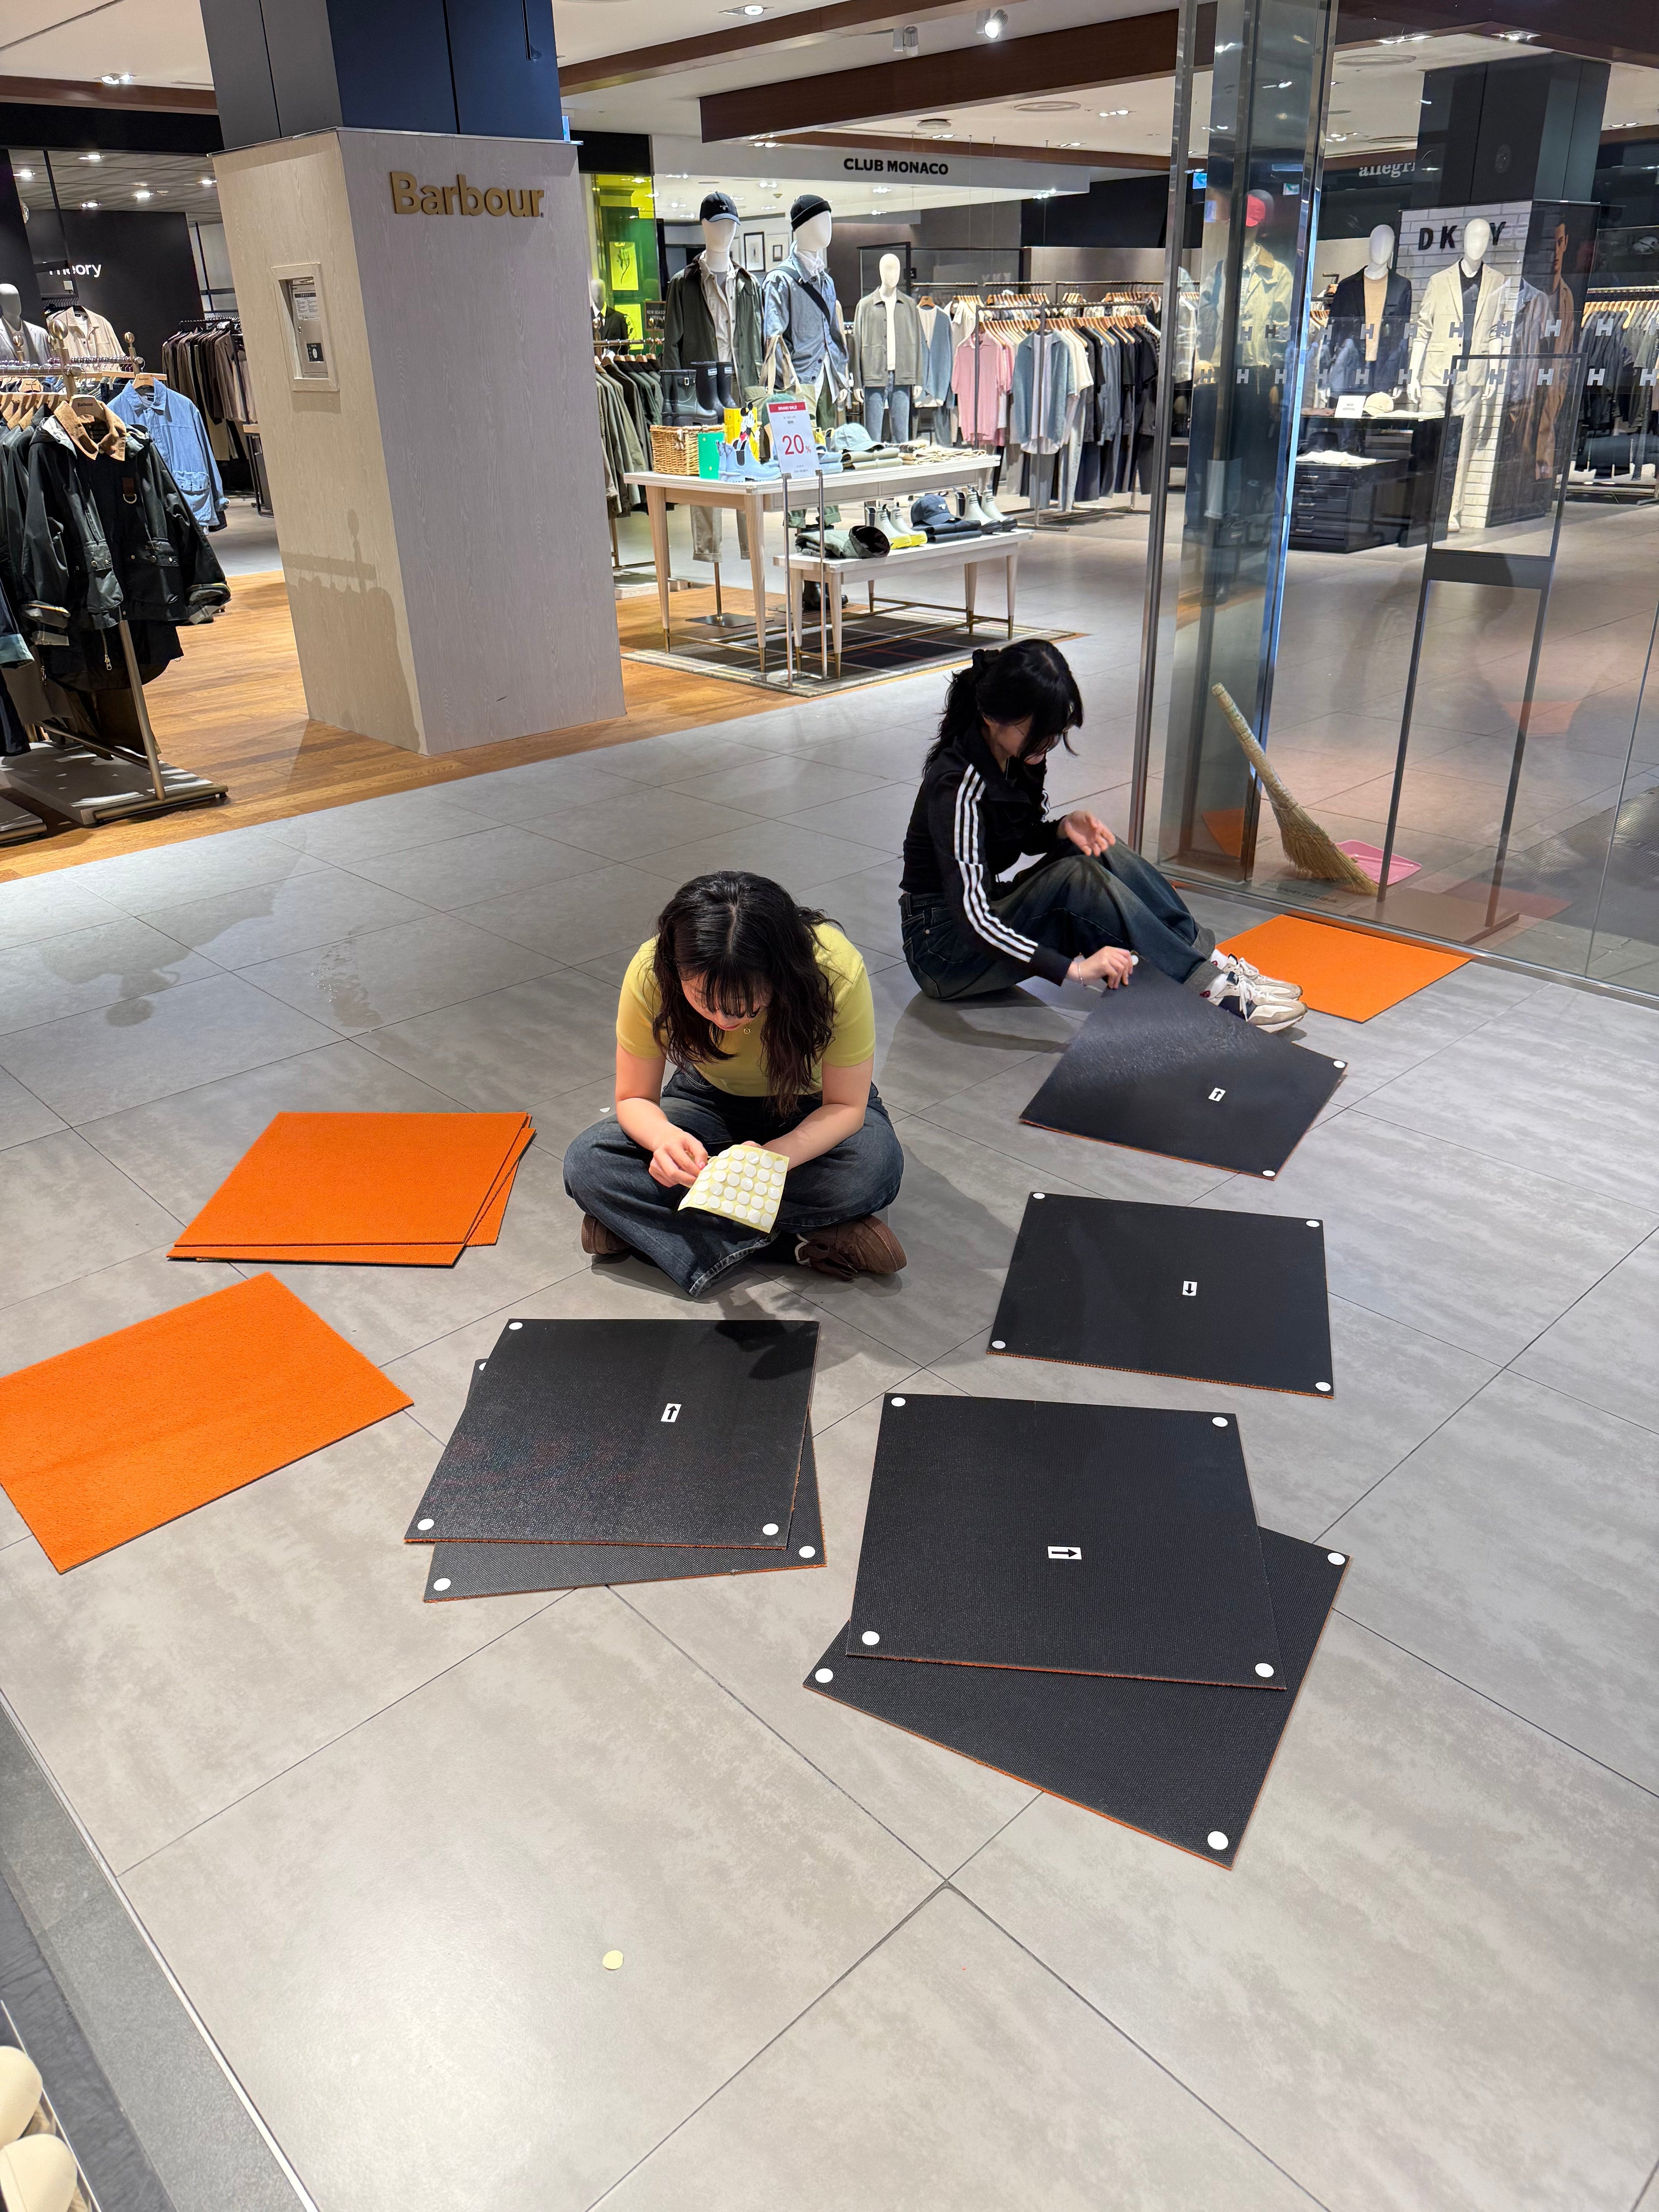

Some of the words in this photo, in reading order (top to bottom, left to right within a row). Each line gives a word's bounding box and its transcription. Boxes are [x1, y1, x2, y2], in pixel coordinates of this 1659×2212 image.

[843, 158, 884, 171] CLUB
[887, 160, 949, 175] MONACO
[390, 172, 544, 217] Barbour
[1418, 221, 1506, 251] DKY
